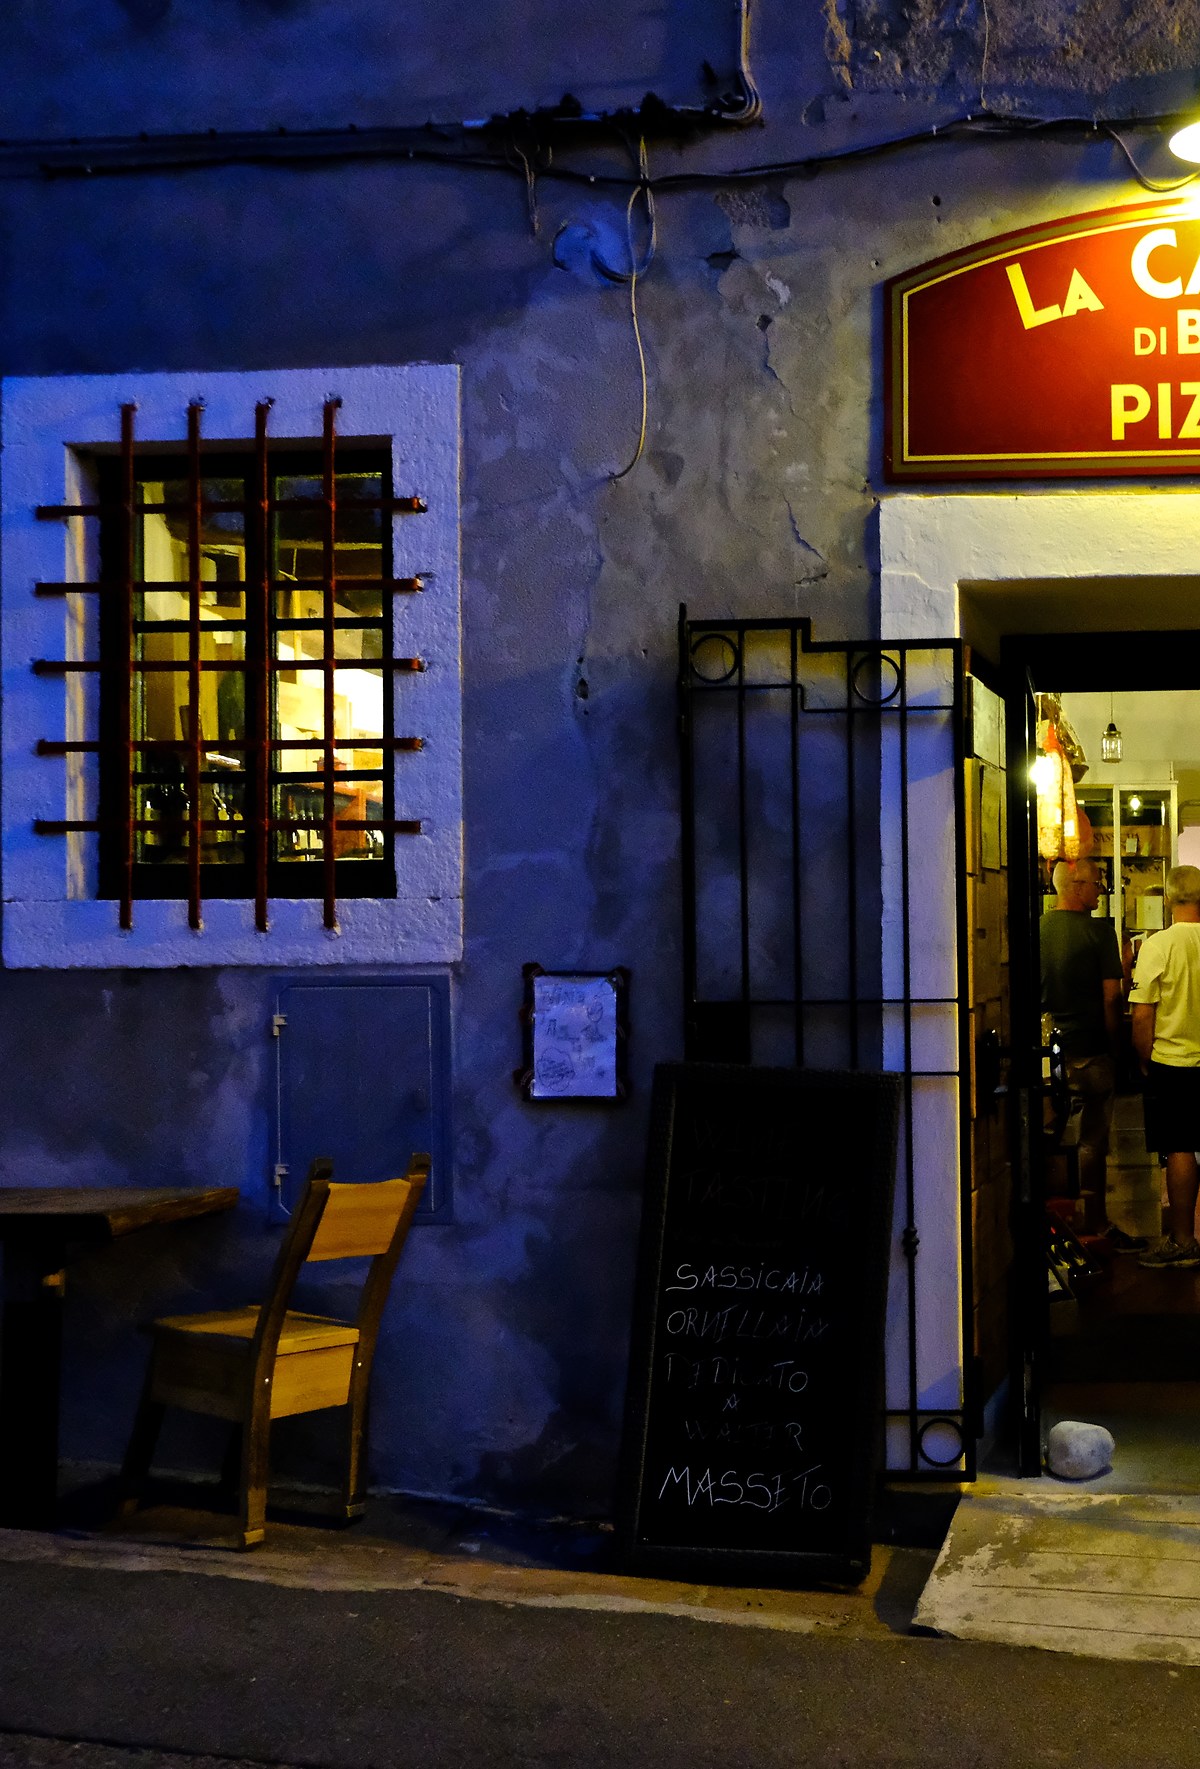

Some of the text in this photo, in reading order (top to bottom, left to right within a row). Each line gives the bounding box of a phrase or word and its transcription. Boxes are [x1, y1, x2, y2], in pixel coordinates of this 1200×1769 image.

[1006, 262, 1104, 330] LA
[1134, 327, 1168, 355] DI
[658, 1463, 833, 1513] MASSETO
